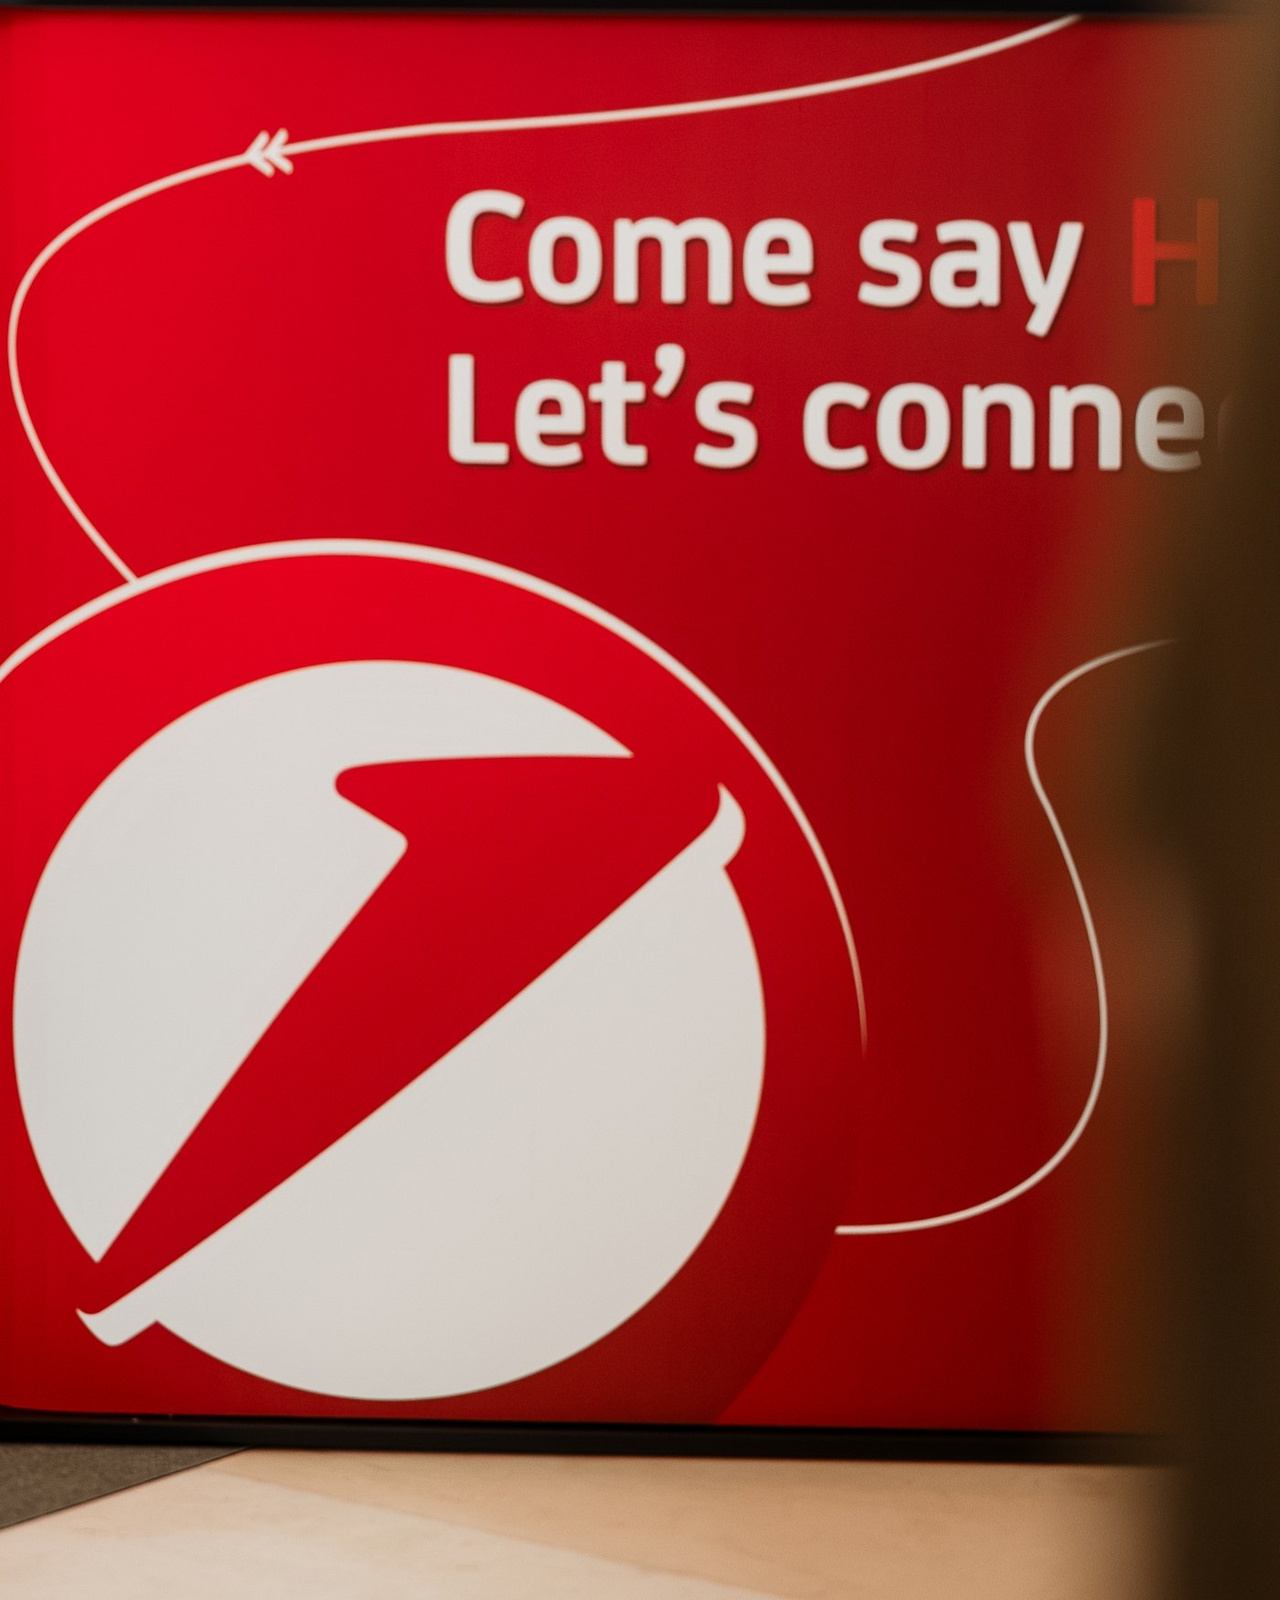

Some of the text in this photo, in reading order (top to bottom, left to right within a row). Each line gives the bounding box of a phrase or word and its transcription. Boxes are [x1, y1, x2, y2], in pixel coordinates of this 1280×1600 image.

[445, 189, 815, 306] Come
[858, 220, 1085, 338] say
[447, 342, 1225, 472] Let’s conne
